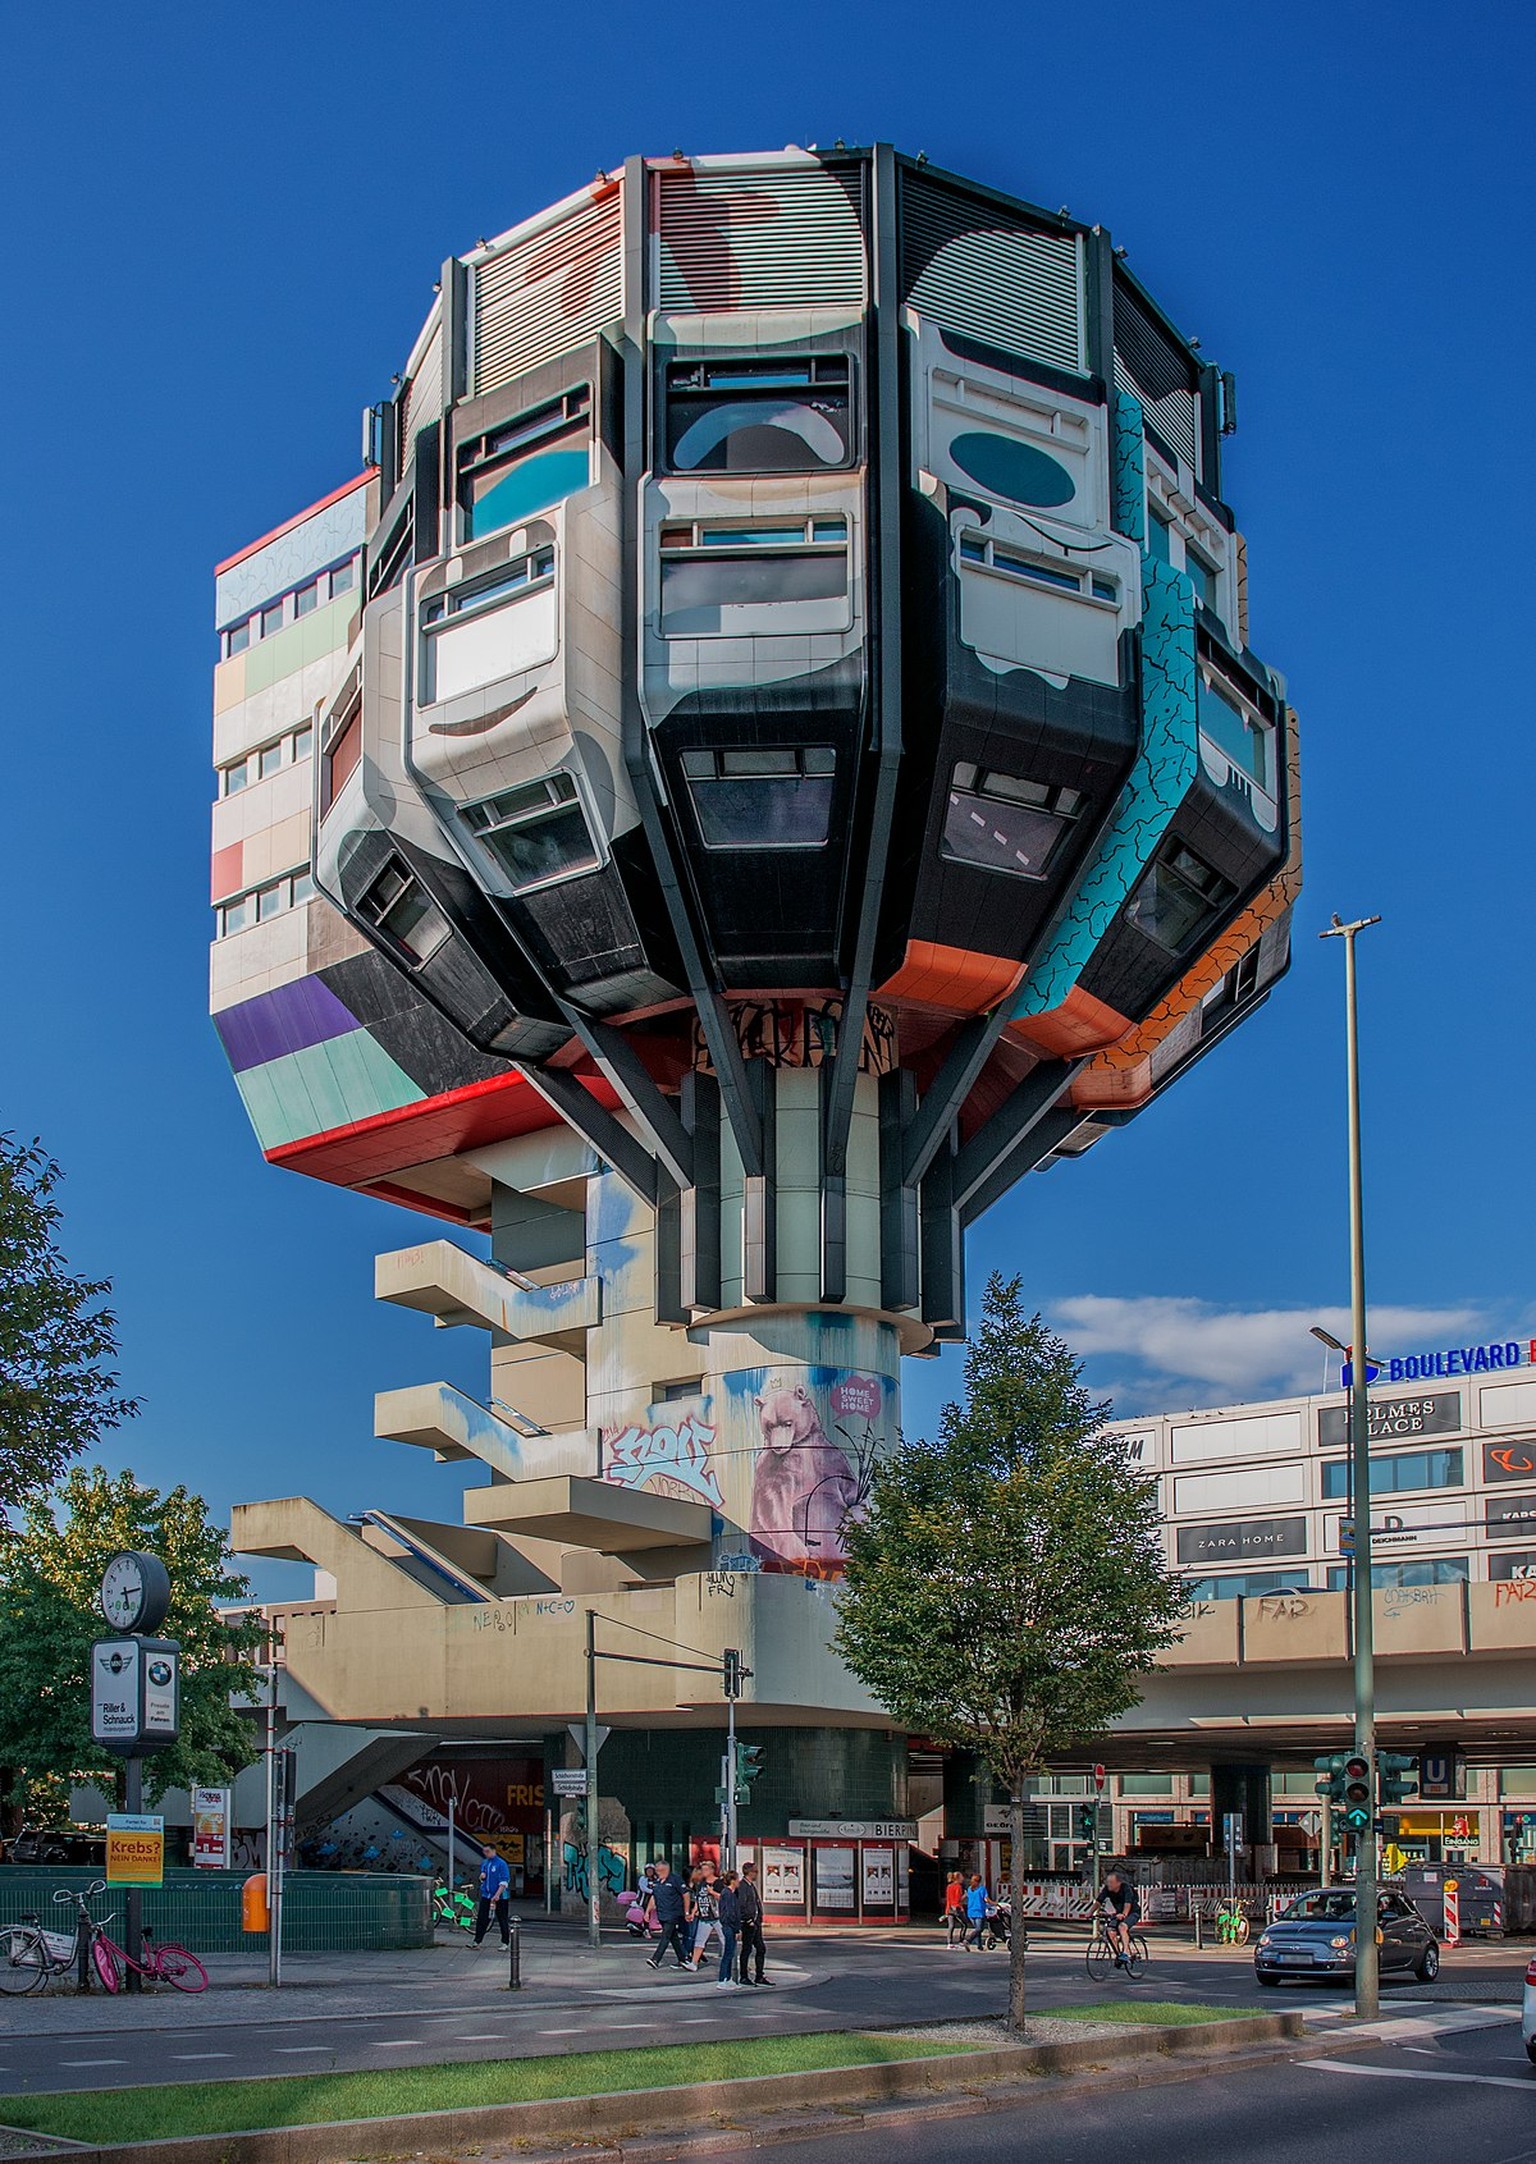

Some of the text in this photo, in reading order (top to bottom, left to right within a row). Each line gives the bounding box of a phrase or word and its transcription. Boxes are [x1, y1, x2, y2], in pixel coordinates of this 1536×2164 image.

[1390, 1342, 1519, 1382] BOULEVARD
[840, 1386, 870, 1399] HOME
[841, 1394, 874, 1406] SWEET
[841, 1402, 870, 1413] HOME
[1199, 1534, 1284, 1548] ZARA HOME
[1372, 1534, 1417, 1544] DEICHMANN
[103, 1703, 119, 1713] Riller
[103, 1714, 135, 1724] Schnauck
[1426, 1760, 1445, 1782] U
[111, 1841, 161, 1853] Krebs?
